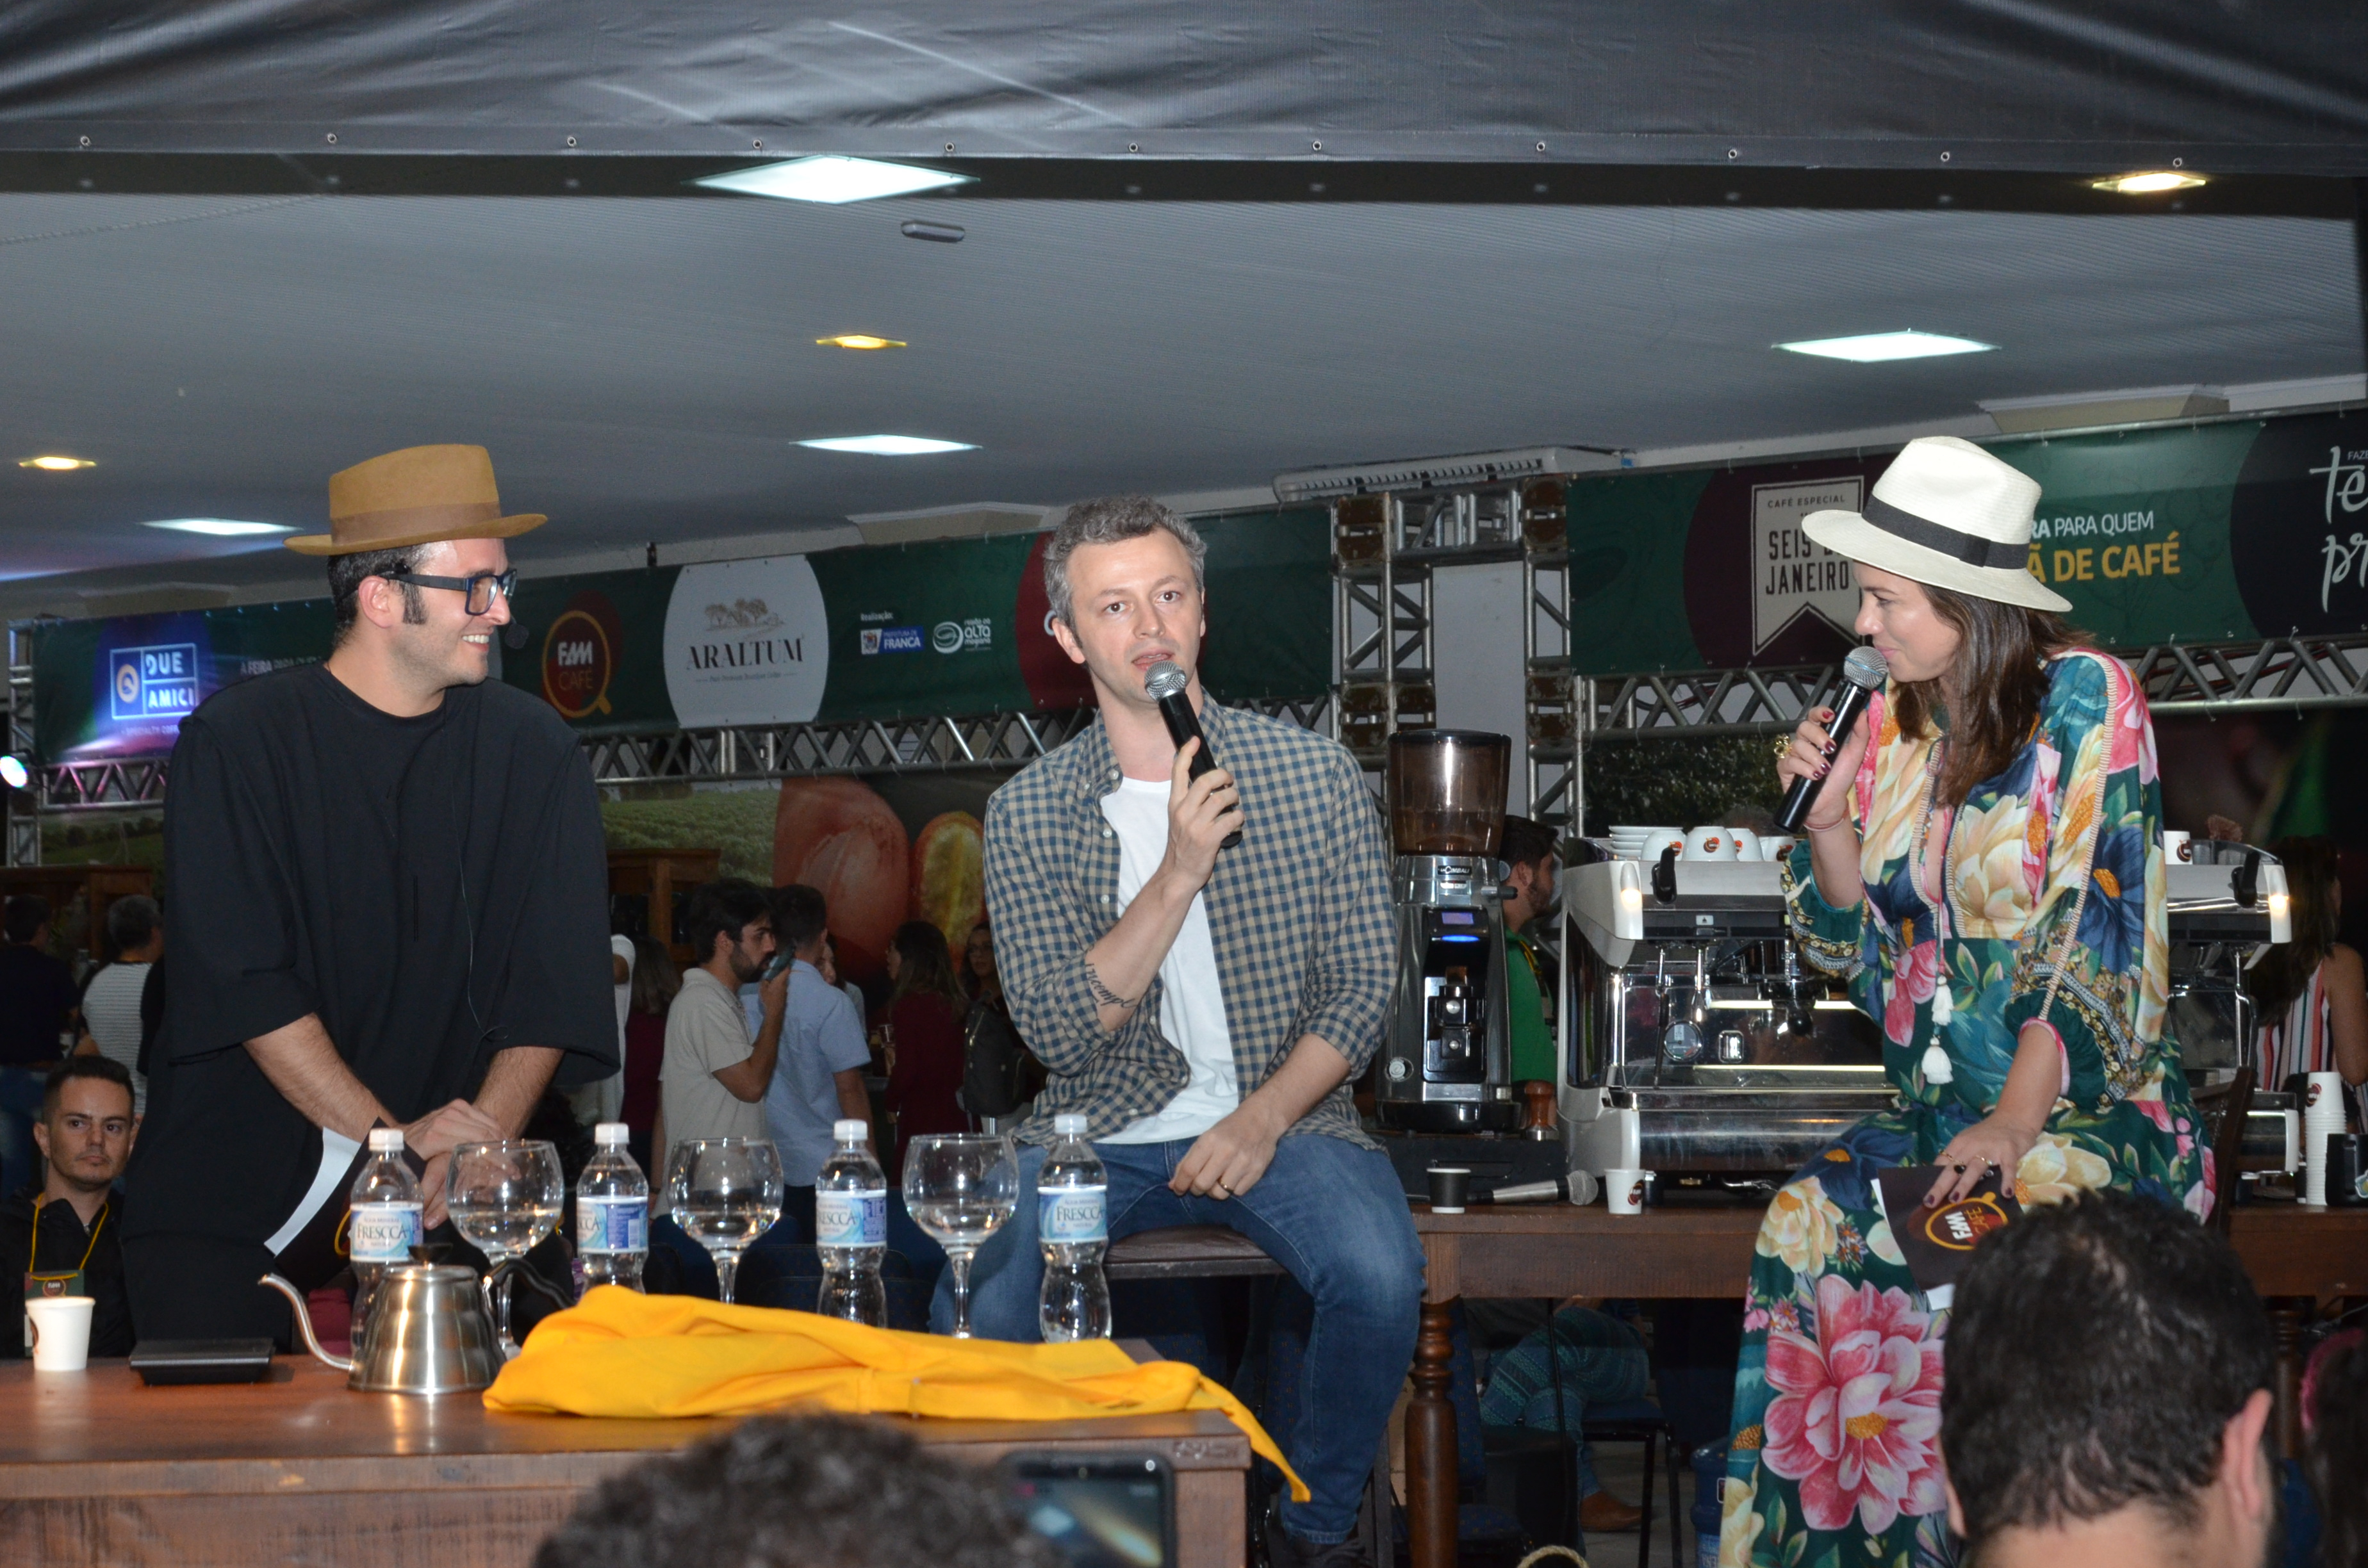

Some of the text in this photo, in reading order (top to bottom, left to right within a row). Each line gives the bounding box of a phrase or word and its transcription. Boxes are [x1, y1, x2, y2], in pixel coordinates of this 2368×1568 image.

[1768, 495, 1845, 508] CAFÉ ESPECIAL
[2030, 510, 2154, 539] RA PARA QUEM
[1769, 529, 1811, 560] SEIS
[2054, 548, 2094, 582] DE
[2101, 530, 2180, 578] CAFÉ
[1766, 560, 1849, 595] JANEIRO
[557, 641, 593, 666] FAM
[686, 638, 803, 670] ARALTUM
[884, 636, 921, 650] FRANCA
[145, 651, 183, 675] DUE
[148, 687, 194, 708] AMICI
[358, 1223, 409, 1239] FRESCCA
[1945, 1211, 1973, 1240] FAM
